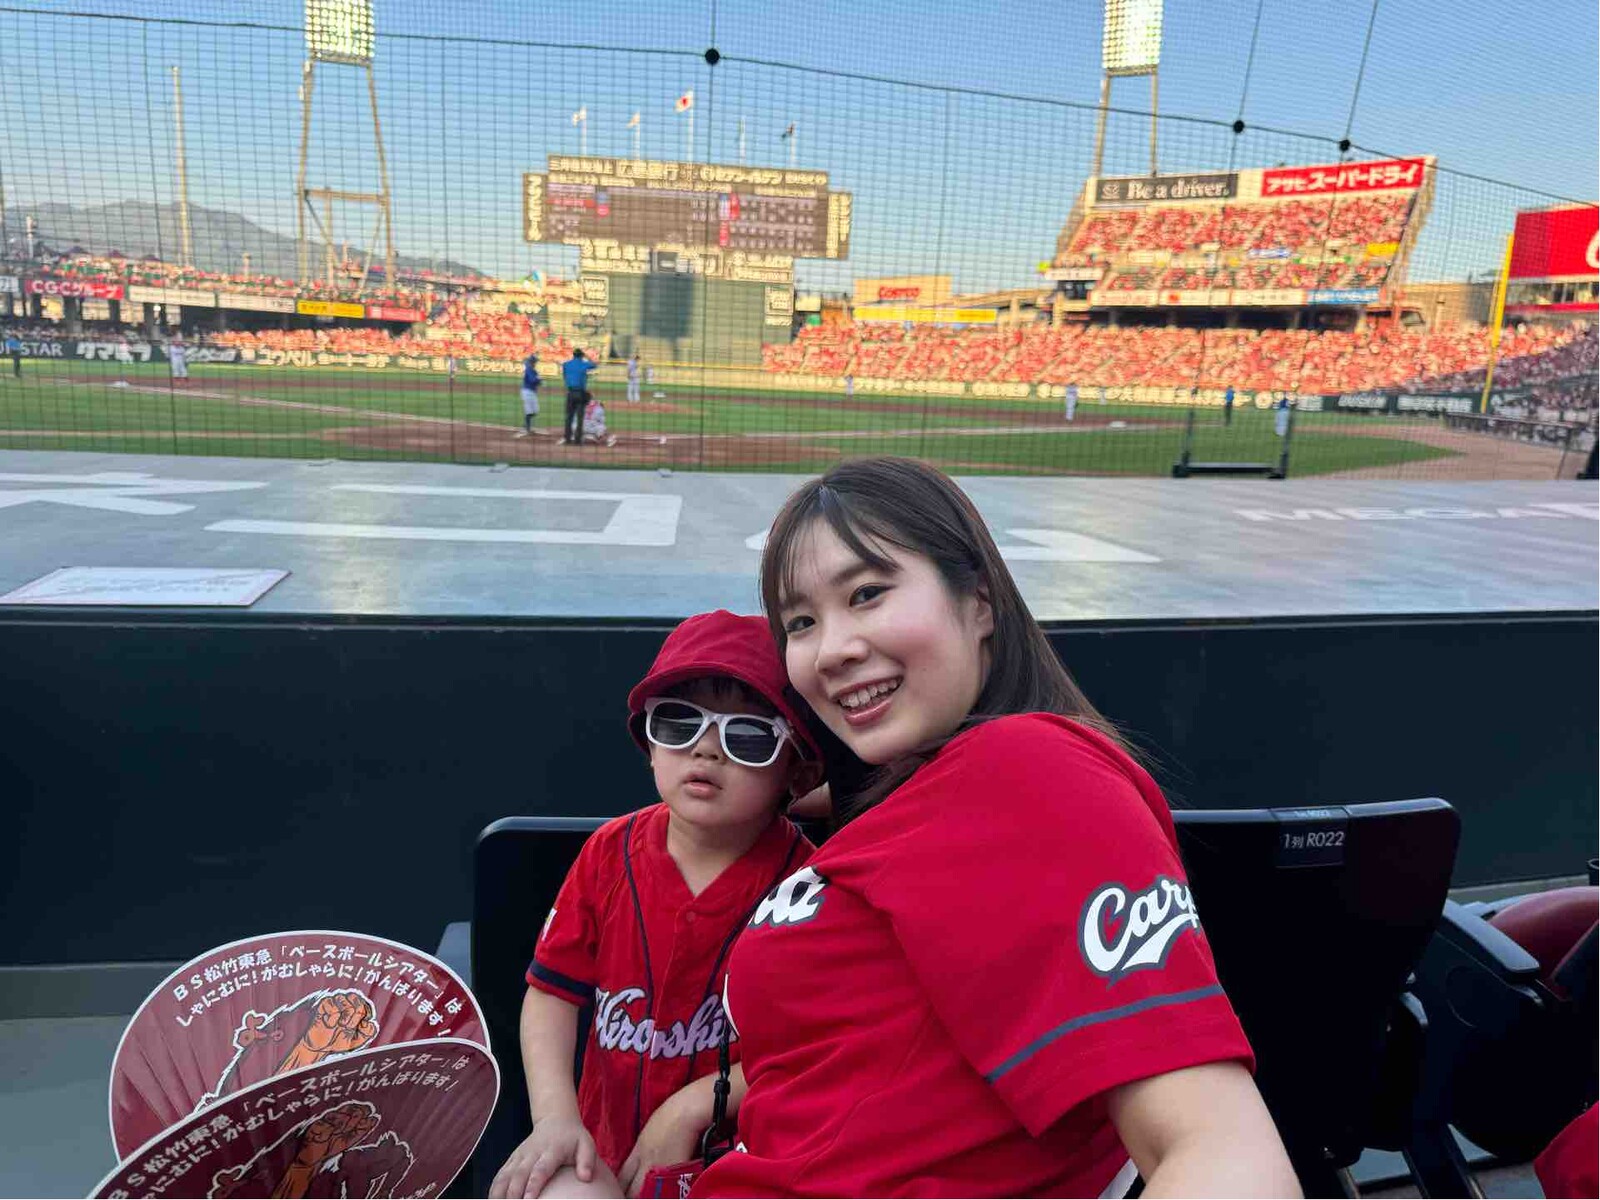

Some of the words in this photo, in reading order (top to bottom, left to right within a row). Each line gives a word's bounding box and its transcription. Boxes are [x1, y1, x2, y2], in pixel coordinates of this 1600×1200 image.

[1127, 180, 1153, 200] Be
[1155, 185, 1168, 199] a
[1171, 178, 1229, 199] driver.
[1267, 164, 1418, 192] アサヒスーパードライ
[31, 279, 119, 299] CGCグループ
[20, 341, 64, 356] STAR
[595, 986, 739, 1060] Hiroshi
